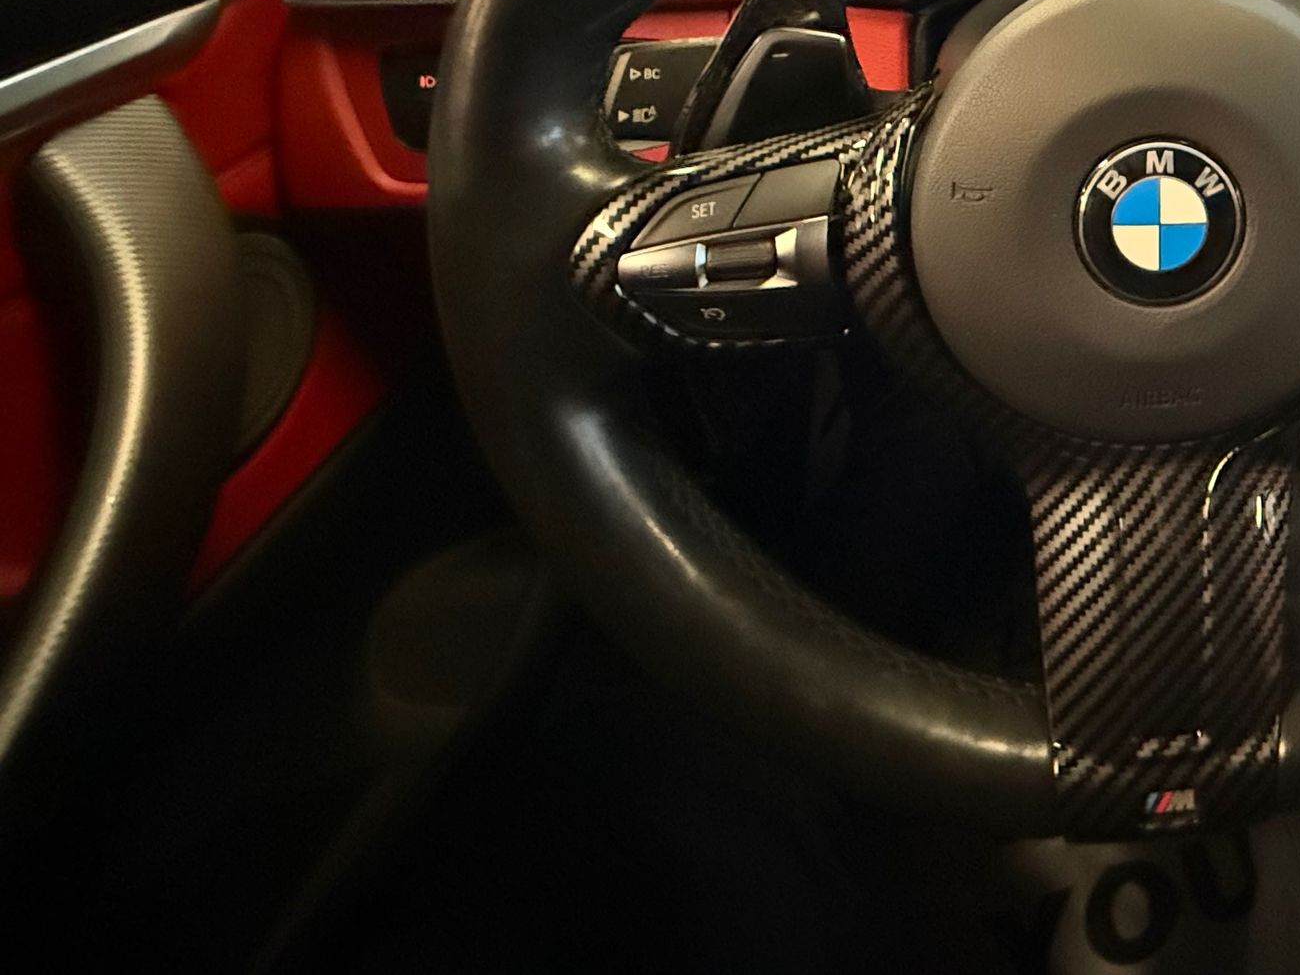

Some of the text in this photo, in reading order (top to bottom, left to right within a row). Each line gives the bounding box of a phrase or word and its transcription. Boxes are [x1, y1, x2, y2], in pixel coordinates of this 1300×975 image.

[644, 68, 661, 79] BC
[1097, 150, 1225, 201] BMW
[691, 201, 717, 219] SET
